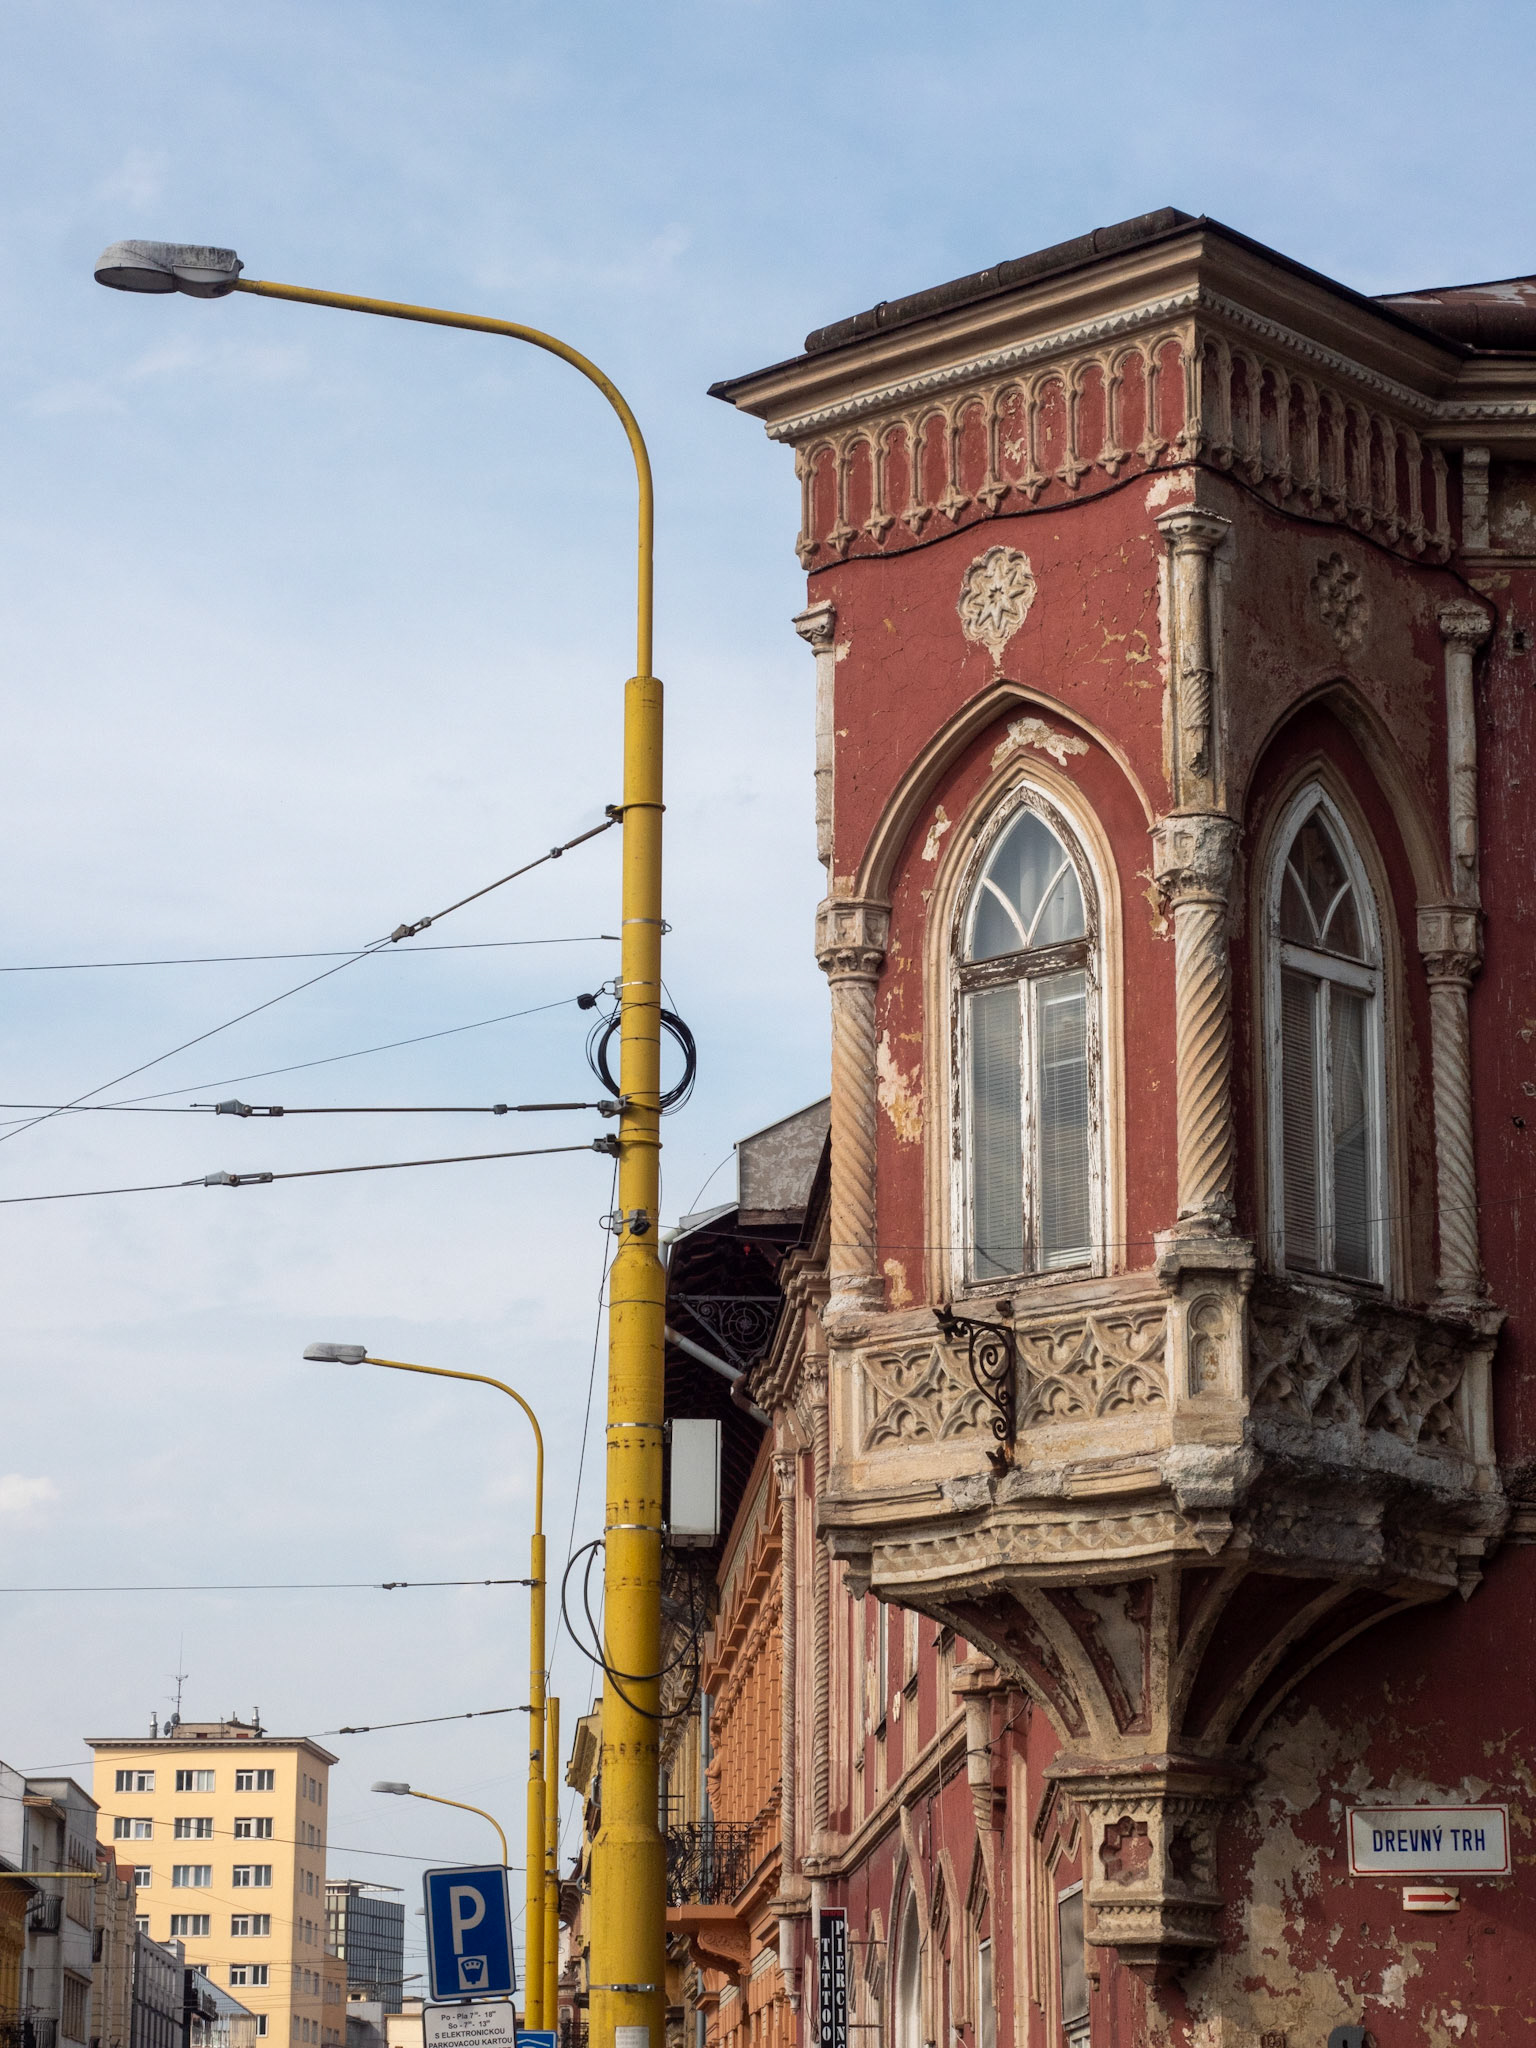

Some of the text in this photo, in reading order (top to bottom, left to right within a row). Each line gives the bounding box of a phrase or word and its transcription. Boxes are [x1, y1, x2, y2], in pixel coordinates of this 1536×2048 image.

[1372, 1825, 1486, 1852] DREVNÝ TRH
[449, 1885, 486, 1955] P
[821, 1937, 832, 2042] TATTOO
[442, 2028, 505, 2039] ELEKTRONICKOU
[482, 2037, 513, 2046] KARTOU
